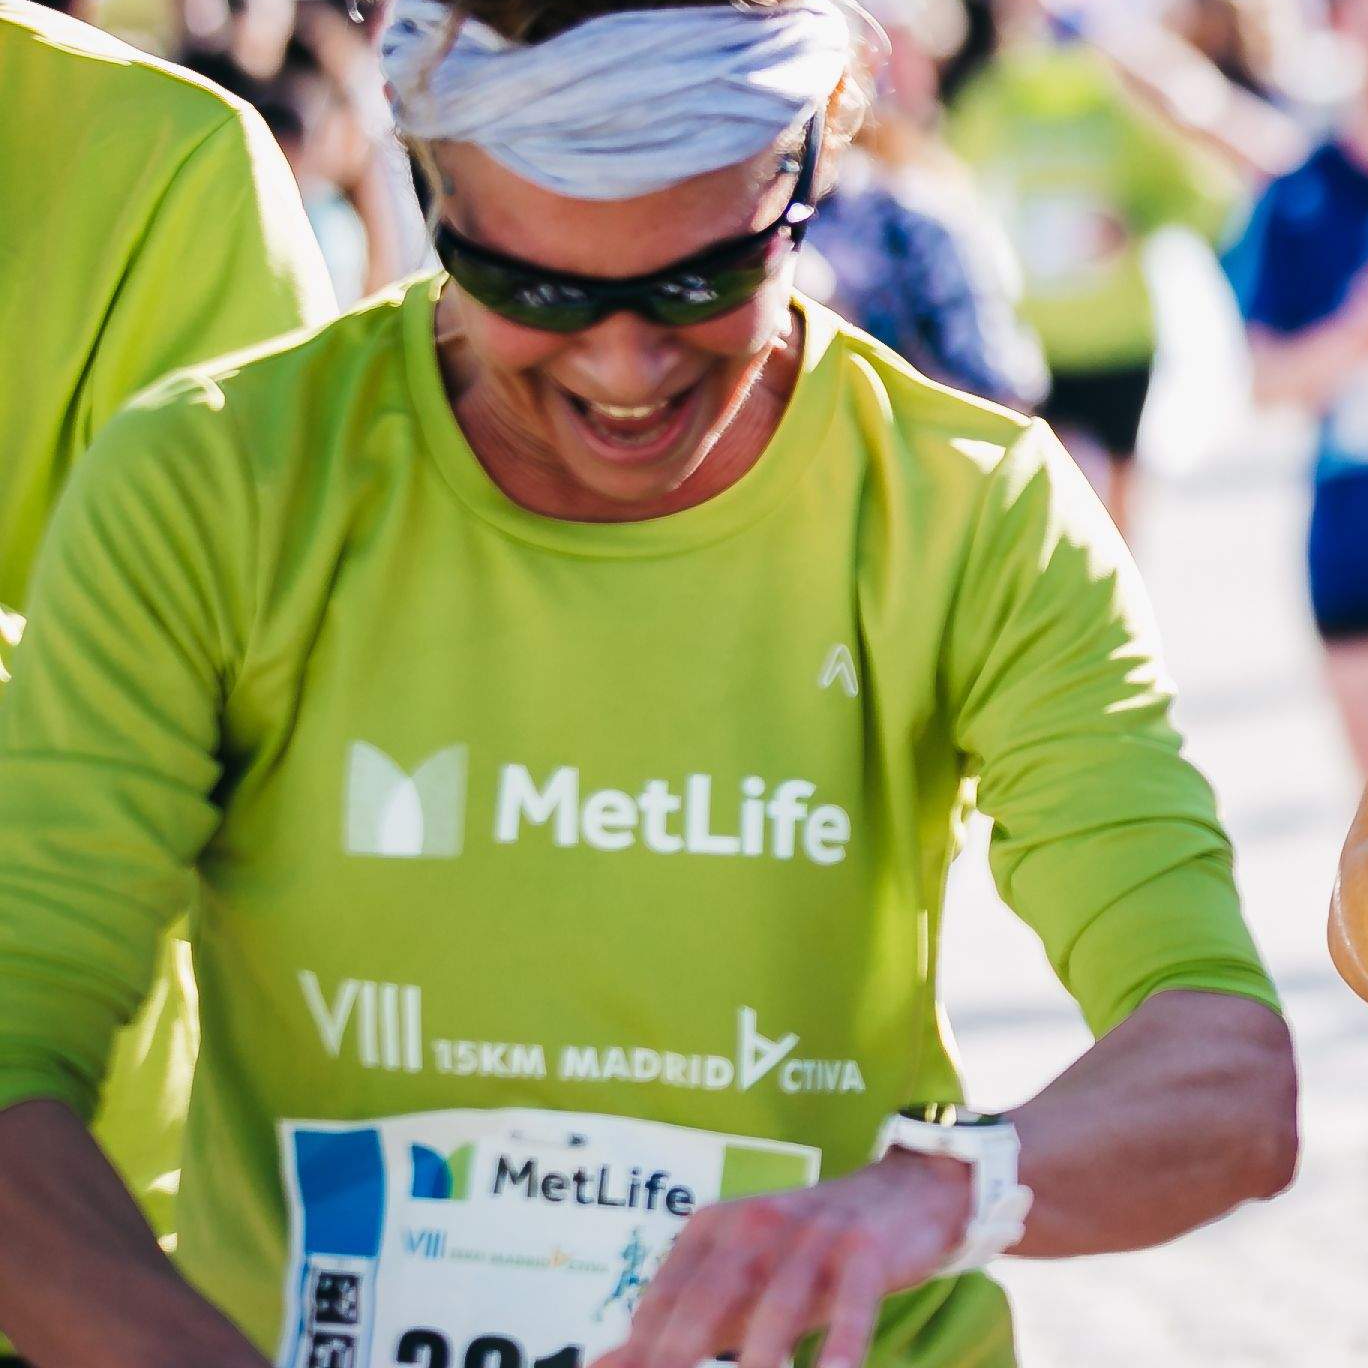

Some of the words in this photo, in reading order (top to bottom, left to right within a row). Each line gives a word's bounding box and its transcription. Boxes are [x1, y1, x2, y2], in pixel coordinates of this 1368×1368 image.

[494, 763, 851, 866] MetLife
[299, 970, 423, 1072] VIII
[431, 1038, 546, 1079] 15KM
[560, 1046, 733, 1090] MADRID
[493, 1152, 697, 1217] MetLife
